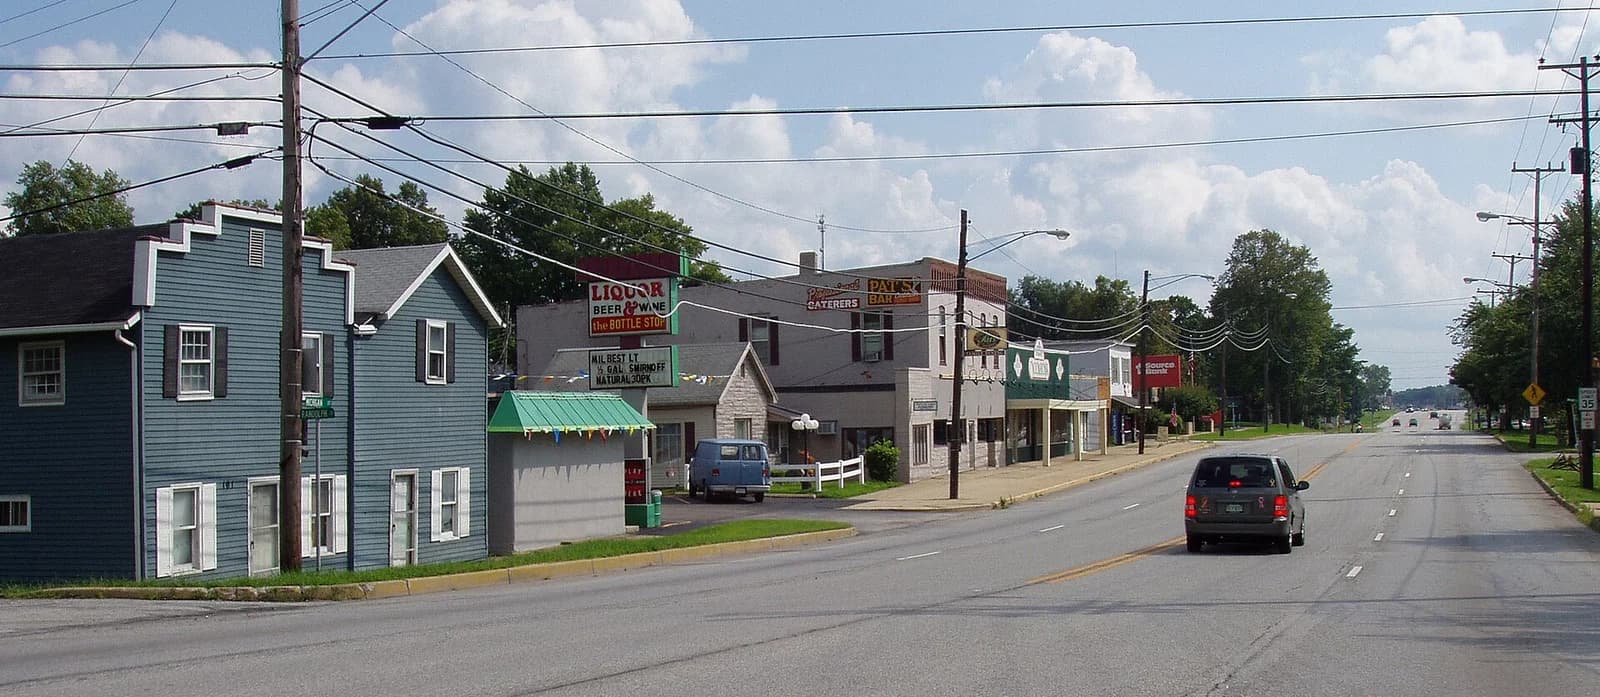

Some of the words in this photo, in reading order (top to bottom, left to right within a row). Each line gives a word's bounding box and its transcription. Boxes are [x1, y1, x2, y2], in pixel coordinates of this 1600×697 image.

[869, 279, 912, 293] PAT'S
[592, 283, 665, 301] LIQUOR
[869, 293, 893, 304] BAR
[593, 304, 622, 315] BEER
[622, 300, 638, 317] &
[638, 301, 666, 312] WINE
[807, 299, 859, 310] CATERERS
[593, 321, 609, 331] the
[609, 316, 641, 330] BOTTLE
[643, 315, 665, 328] STOP
[628, 353, 639, 363] LT
[629, 362, 666, 373] SMIRNOFF
[596, 375, 631, 385] NATURAL
[1582, 399, 1594, 409] 35
